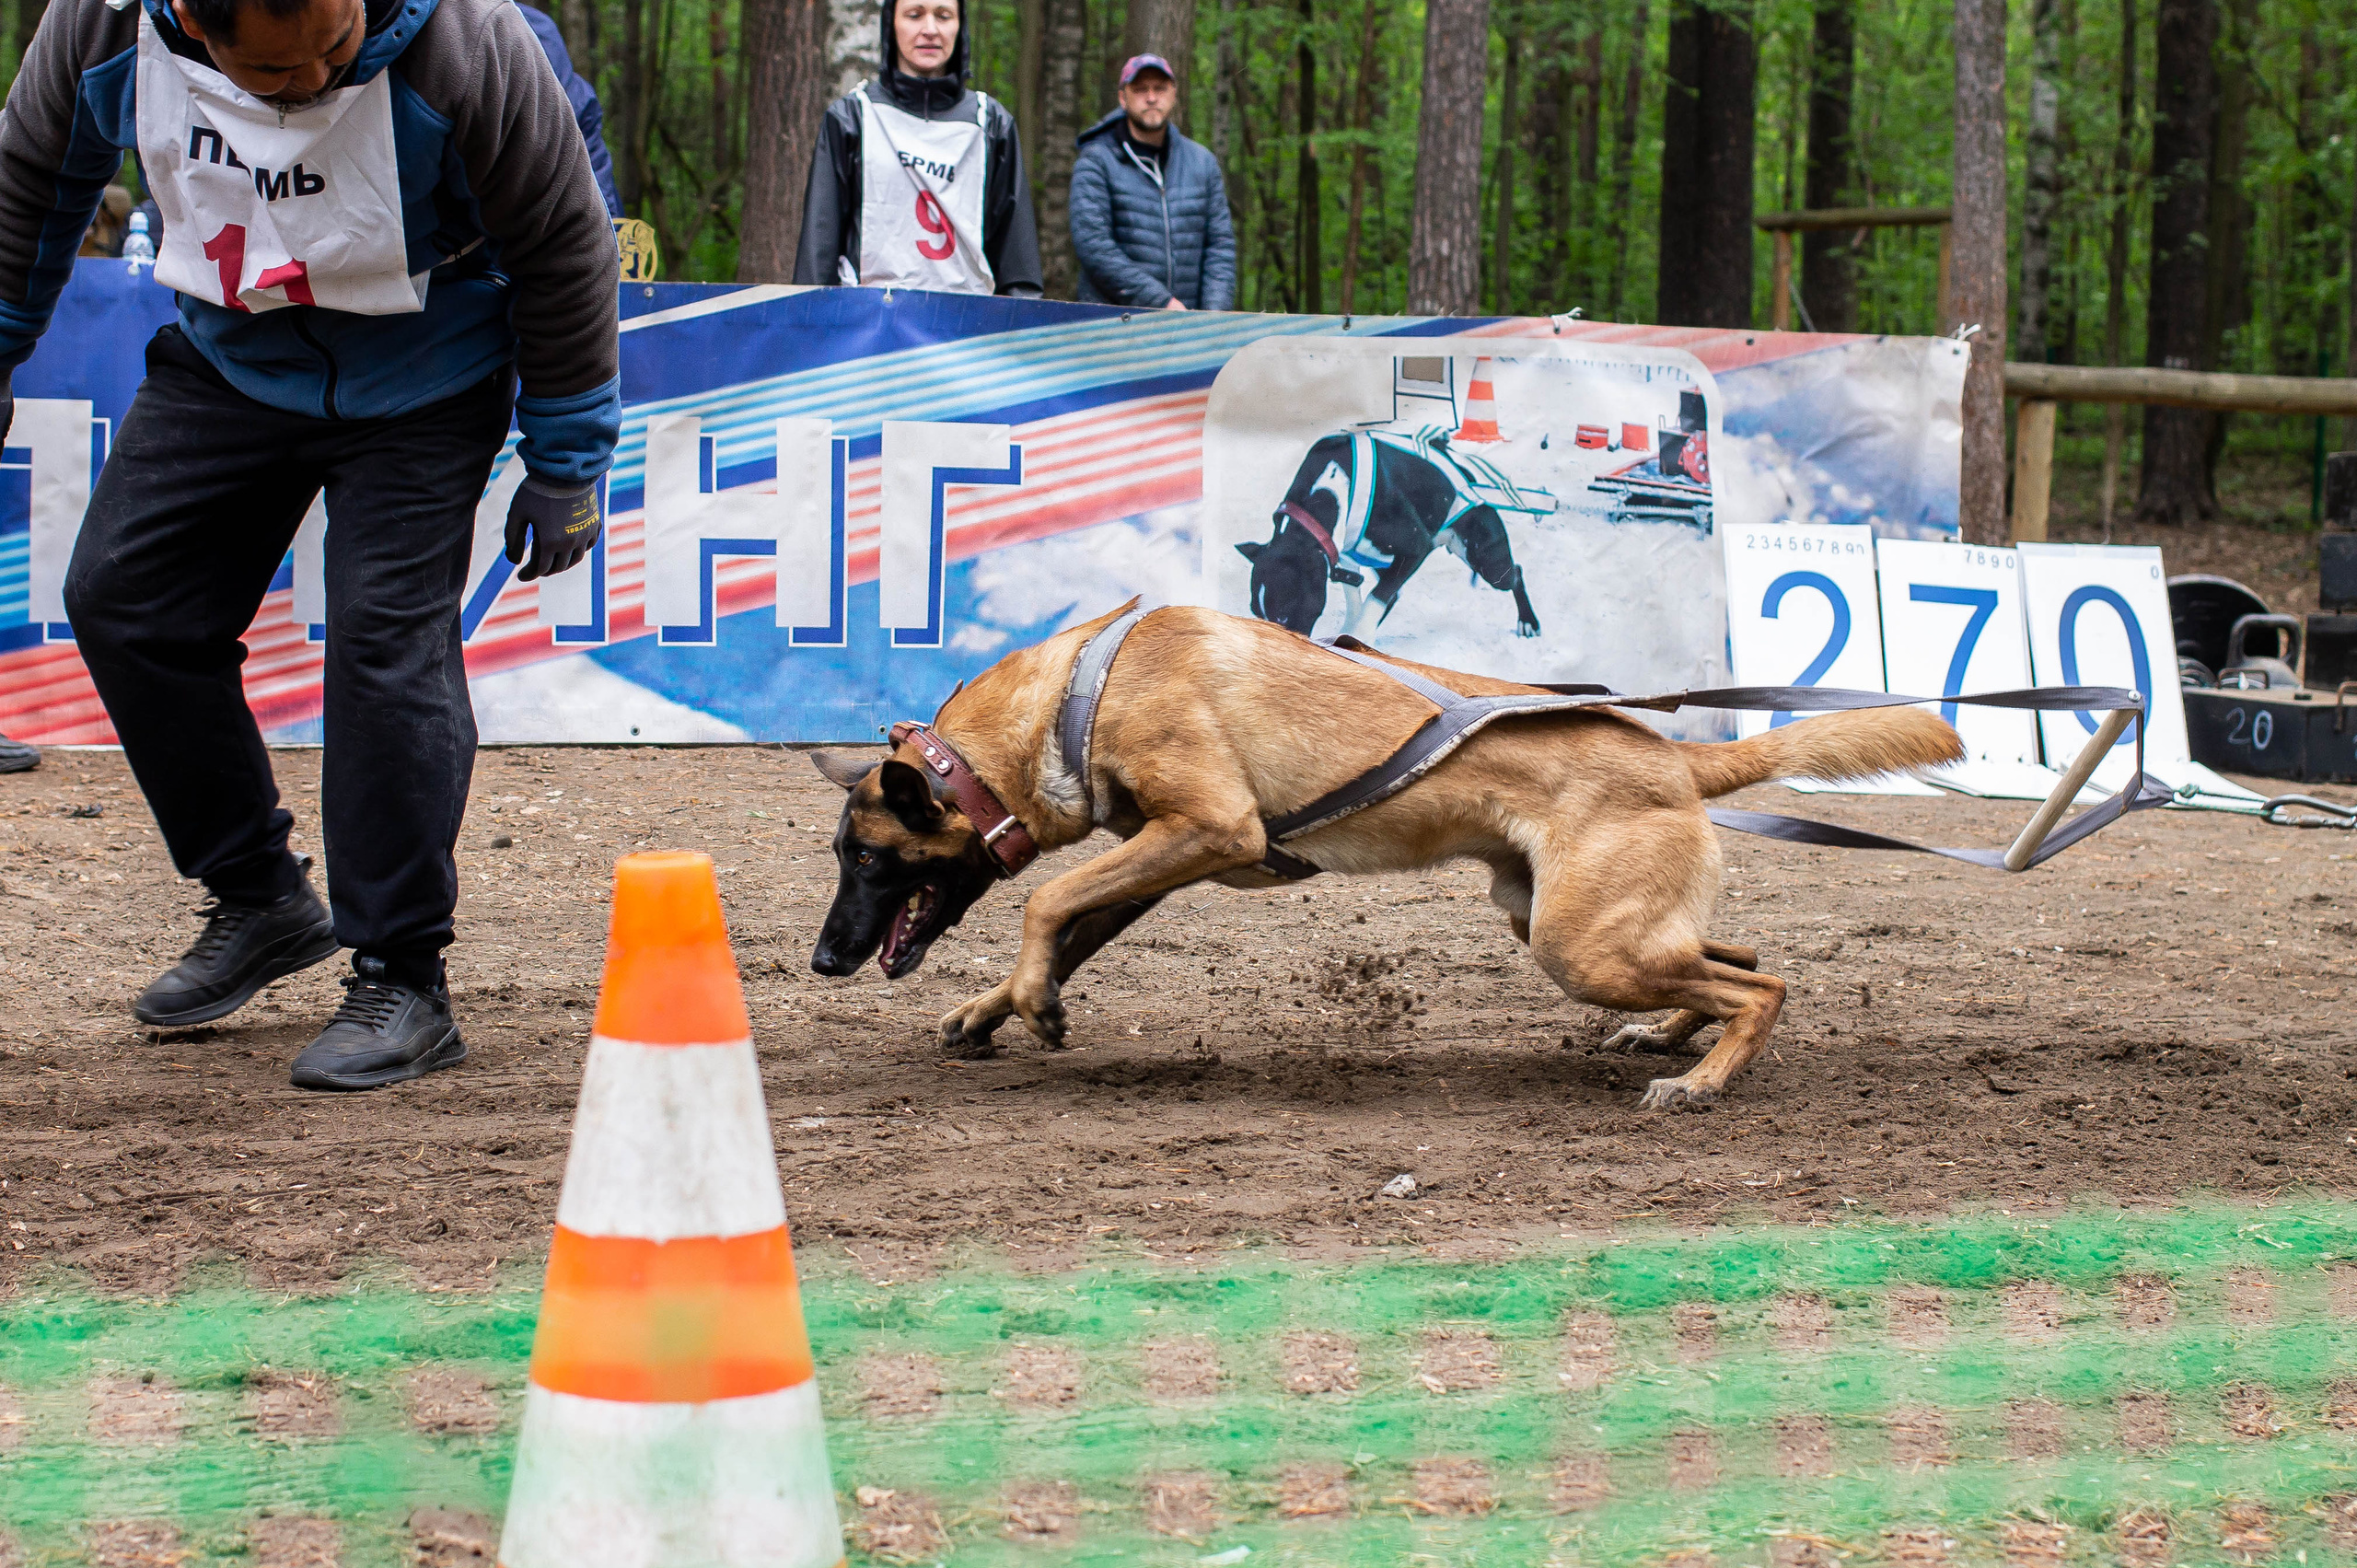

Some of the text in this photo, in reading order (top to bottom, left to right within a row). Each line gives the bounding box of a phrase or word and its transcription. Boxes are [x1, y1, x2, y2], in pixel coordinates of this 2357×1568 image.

[189, 125, 326, 202] ПМЬ
[897, 151, 955, 182] ЕРМЬ
[915, 189, 956, 261] 9
[2225, 706, 2274, 750] 20
